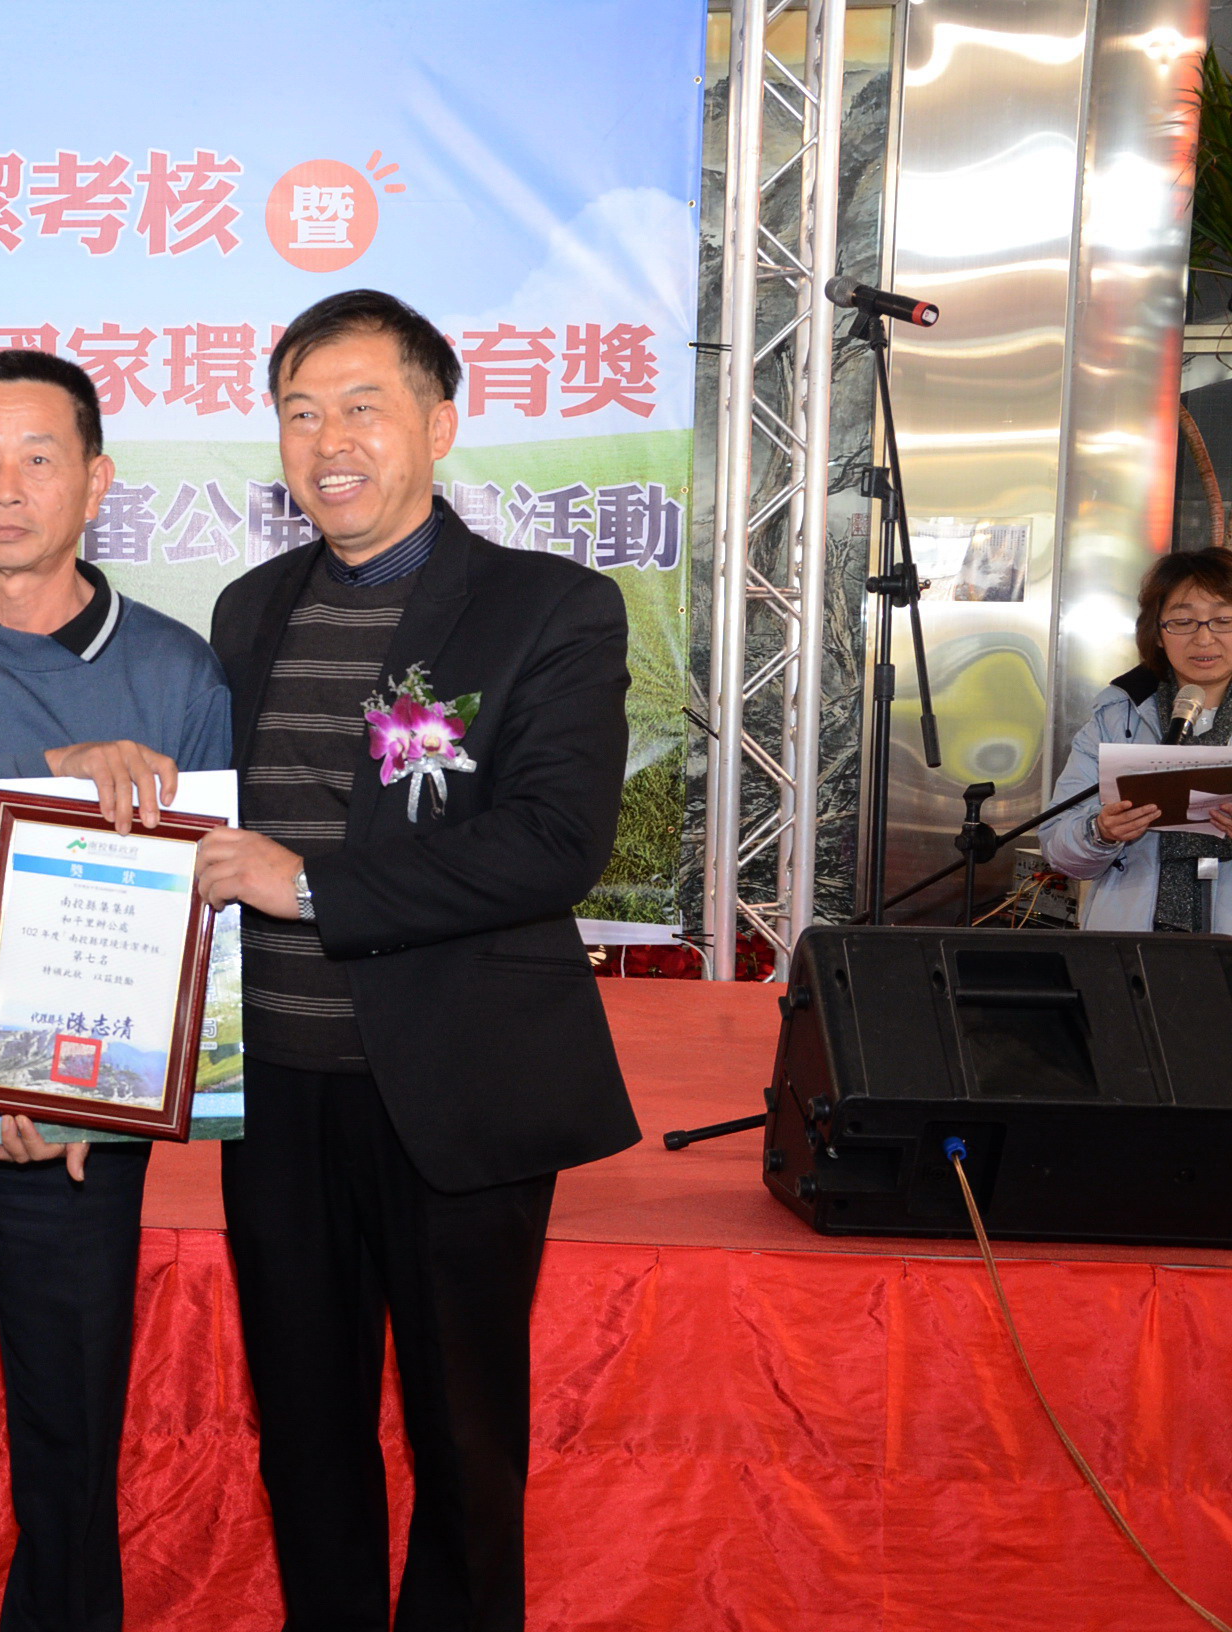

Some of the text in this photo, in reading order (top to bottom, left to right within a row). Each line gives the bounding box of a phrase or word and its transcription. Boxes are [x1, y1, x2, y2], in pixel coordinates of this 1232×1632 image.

[288, 184, 355, 249] 暨
[72, 950, 109, 966] 第七名
